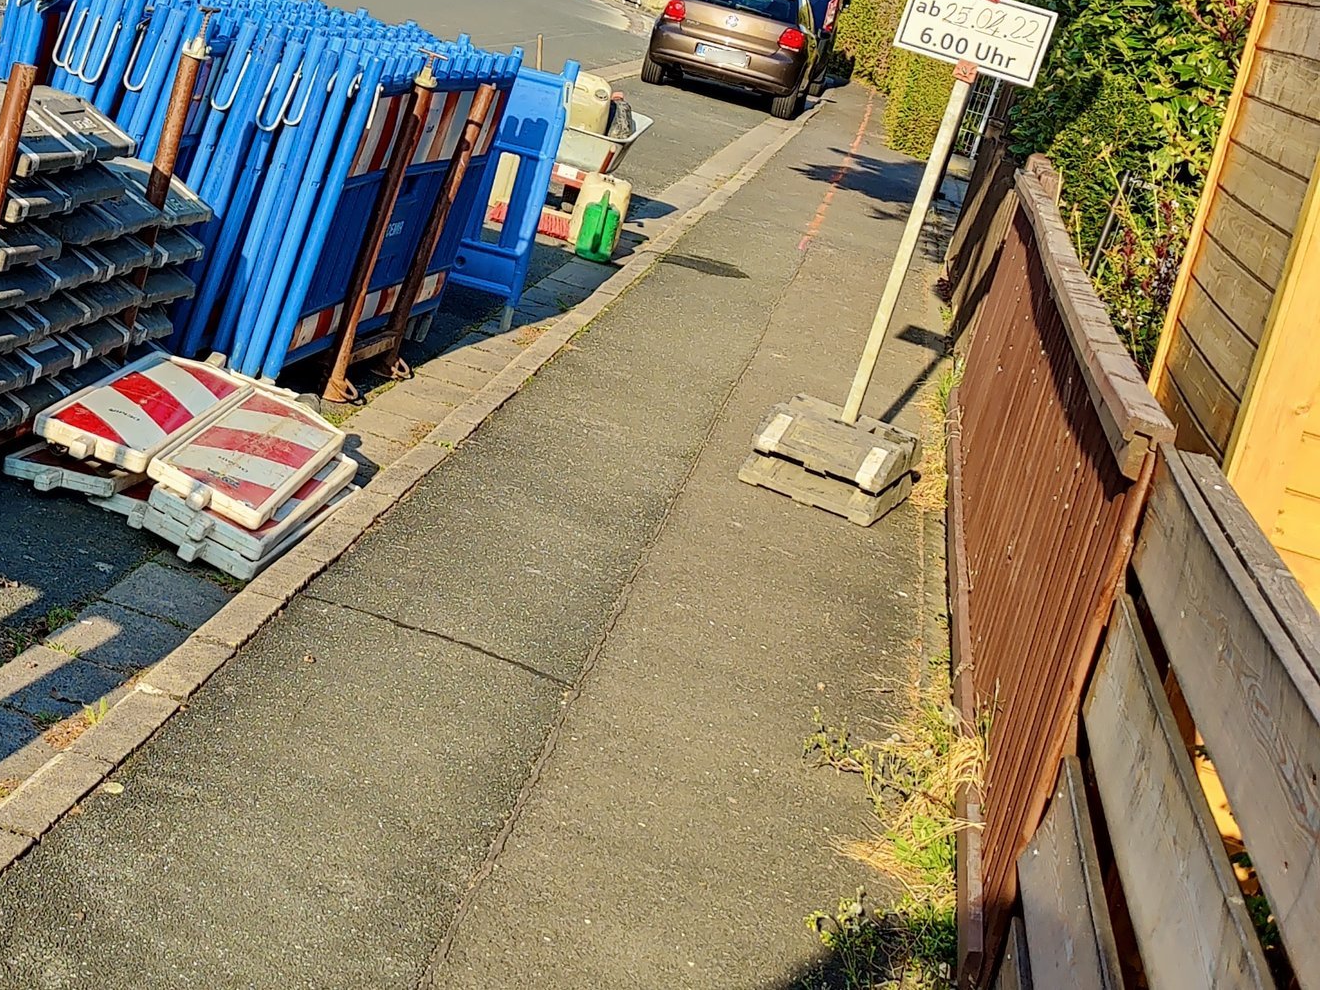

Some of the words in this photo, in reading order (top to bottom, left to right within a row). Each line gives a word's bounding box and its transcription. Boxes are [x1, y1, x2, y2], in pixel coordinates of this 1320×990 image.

[916, 0, 941, 17] ab
[919, 27, 969, 55] 6.00
[975, 42, 1016, 69] Uhr
